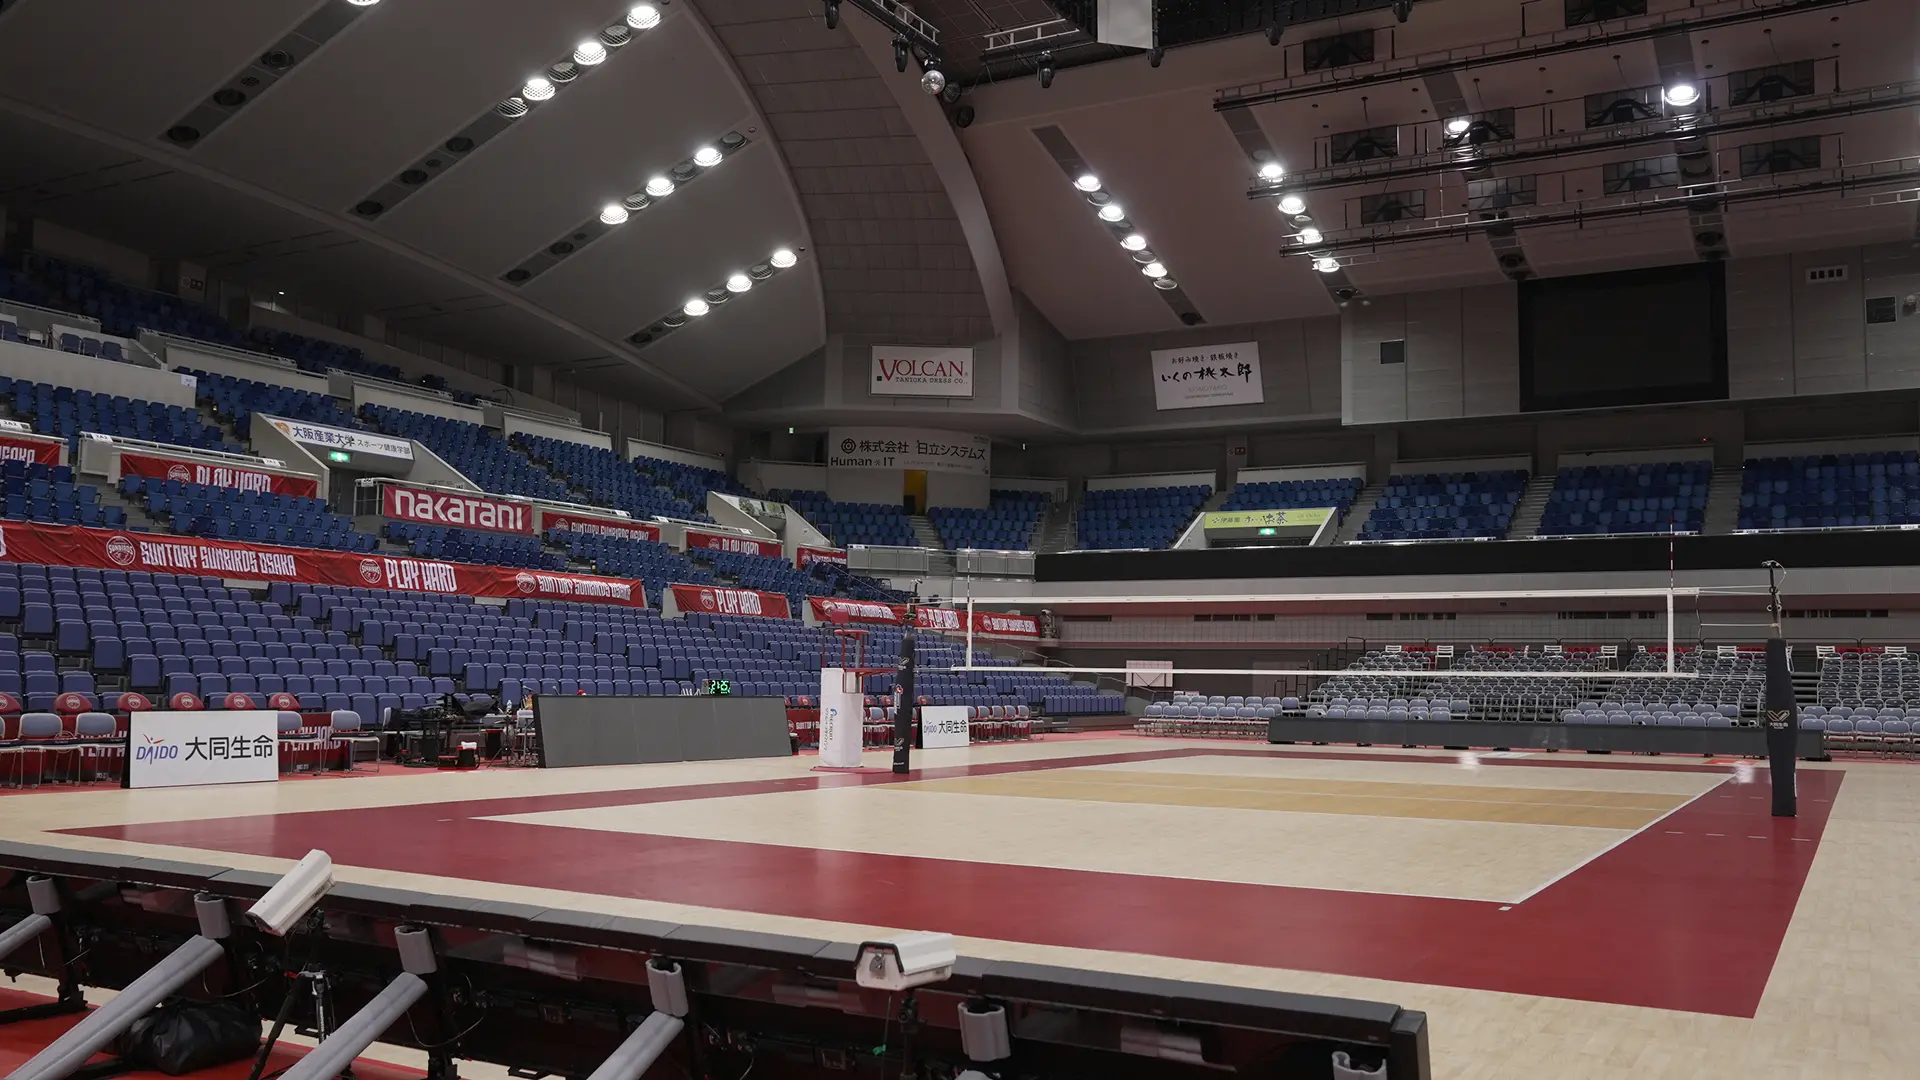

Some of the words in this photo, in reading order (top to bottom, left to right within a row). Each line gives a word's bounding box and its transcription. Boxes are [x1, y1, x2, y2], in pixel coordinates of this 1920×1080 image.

[878, 358, 964, 381] VOLCAN
[895, 376, 928, 384] TANIOKA
[1160, 362, 1253, 383] いくの桃太郎
[293, 425, 356, 448] 大阪産業大学
[357, 439, 411, 455] スポーツ健康学部
[859, 439, 910, 454] 株式会社
[916, 441, 986, 461] 日立システムズ
[830, 456, 872, 467] Human
[883, 457, 895, 467] IT
[140, 541, 198, 569] SUNTORY
[200, 546, 258, 573] SUNBIRDS
[259, 552, 297, 576] OSAKA
[384, 558, 420, 589] PLAY
[420, 562, 457, 592] HARD
[536, 575, 574, 594] SUNTORY
[714, 589, 738, 613] PLAY
[738, 591, 762, 615] HARD
[938, 719, 968, 734] 大同生命
[136, 744, 179, 762] DAIDO
[184, 734, 274, 761] 大同生命
